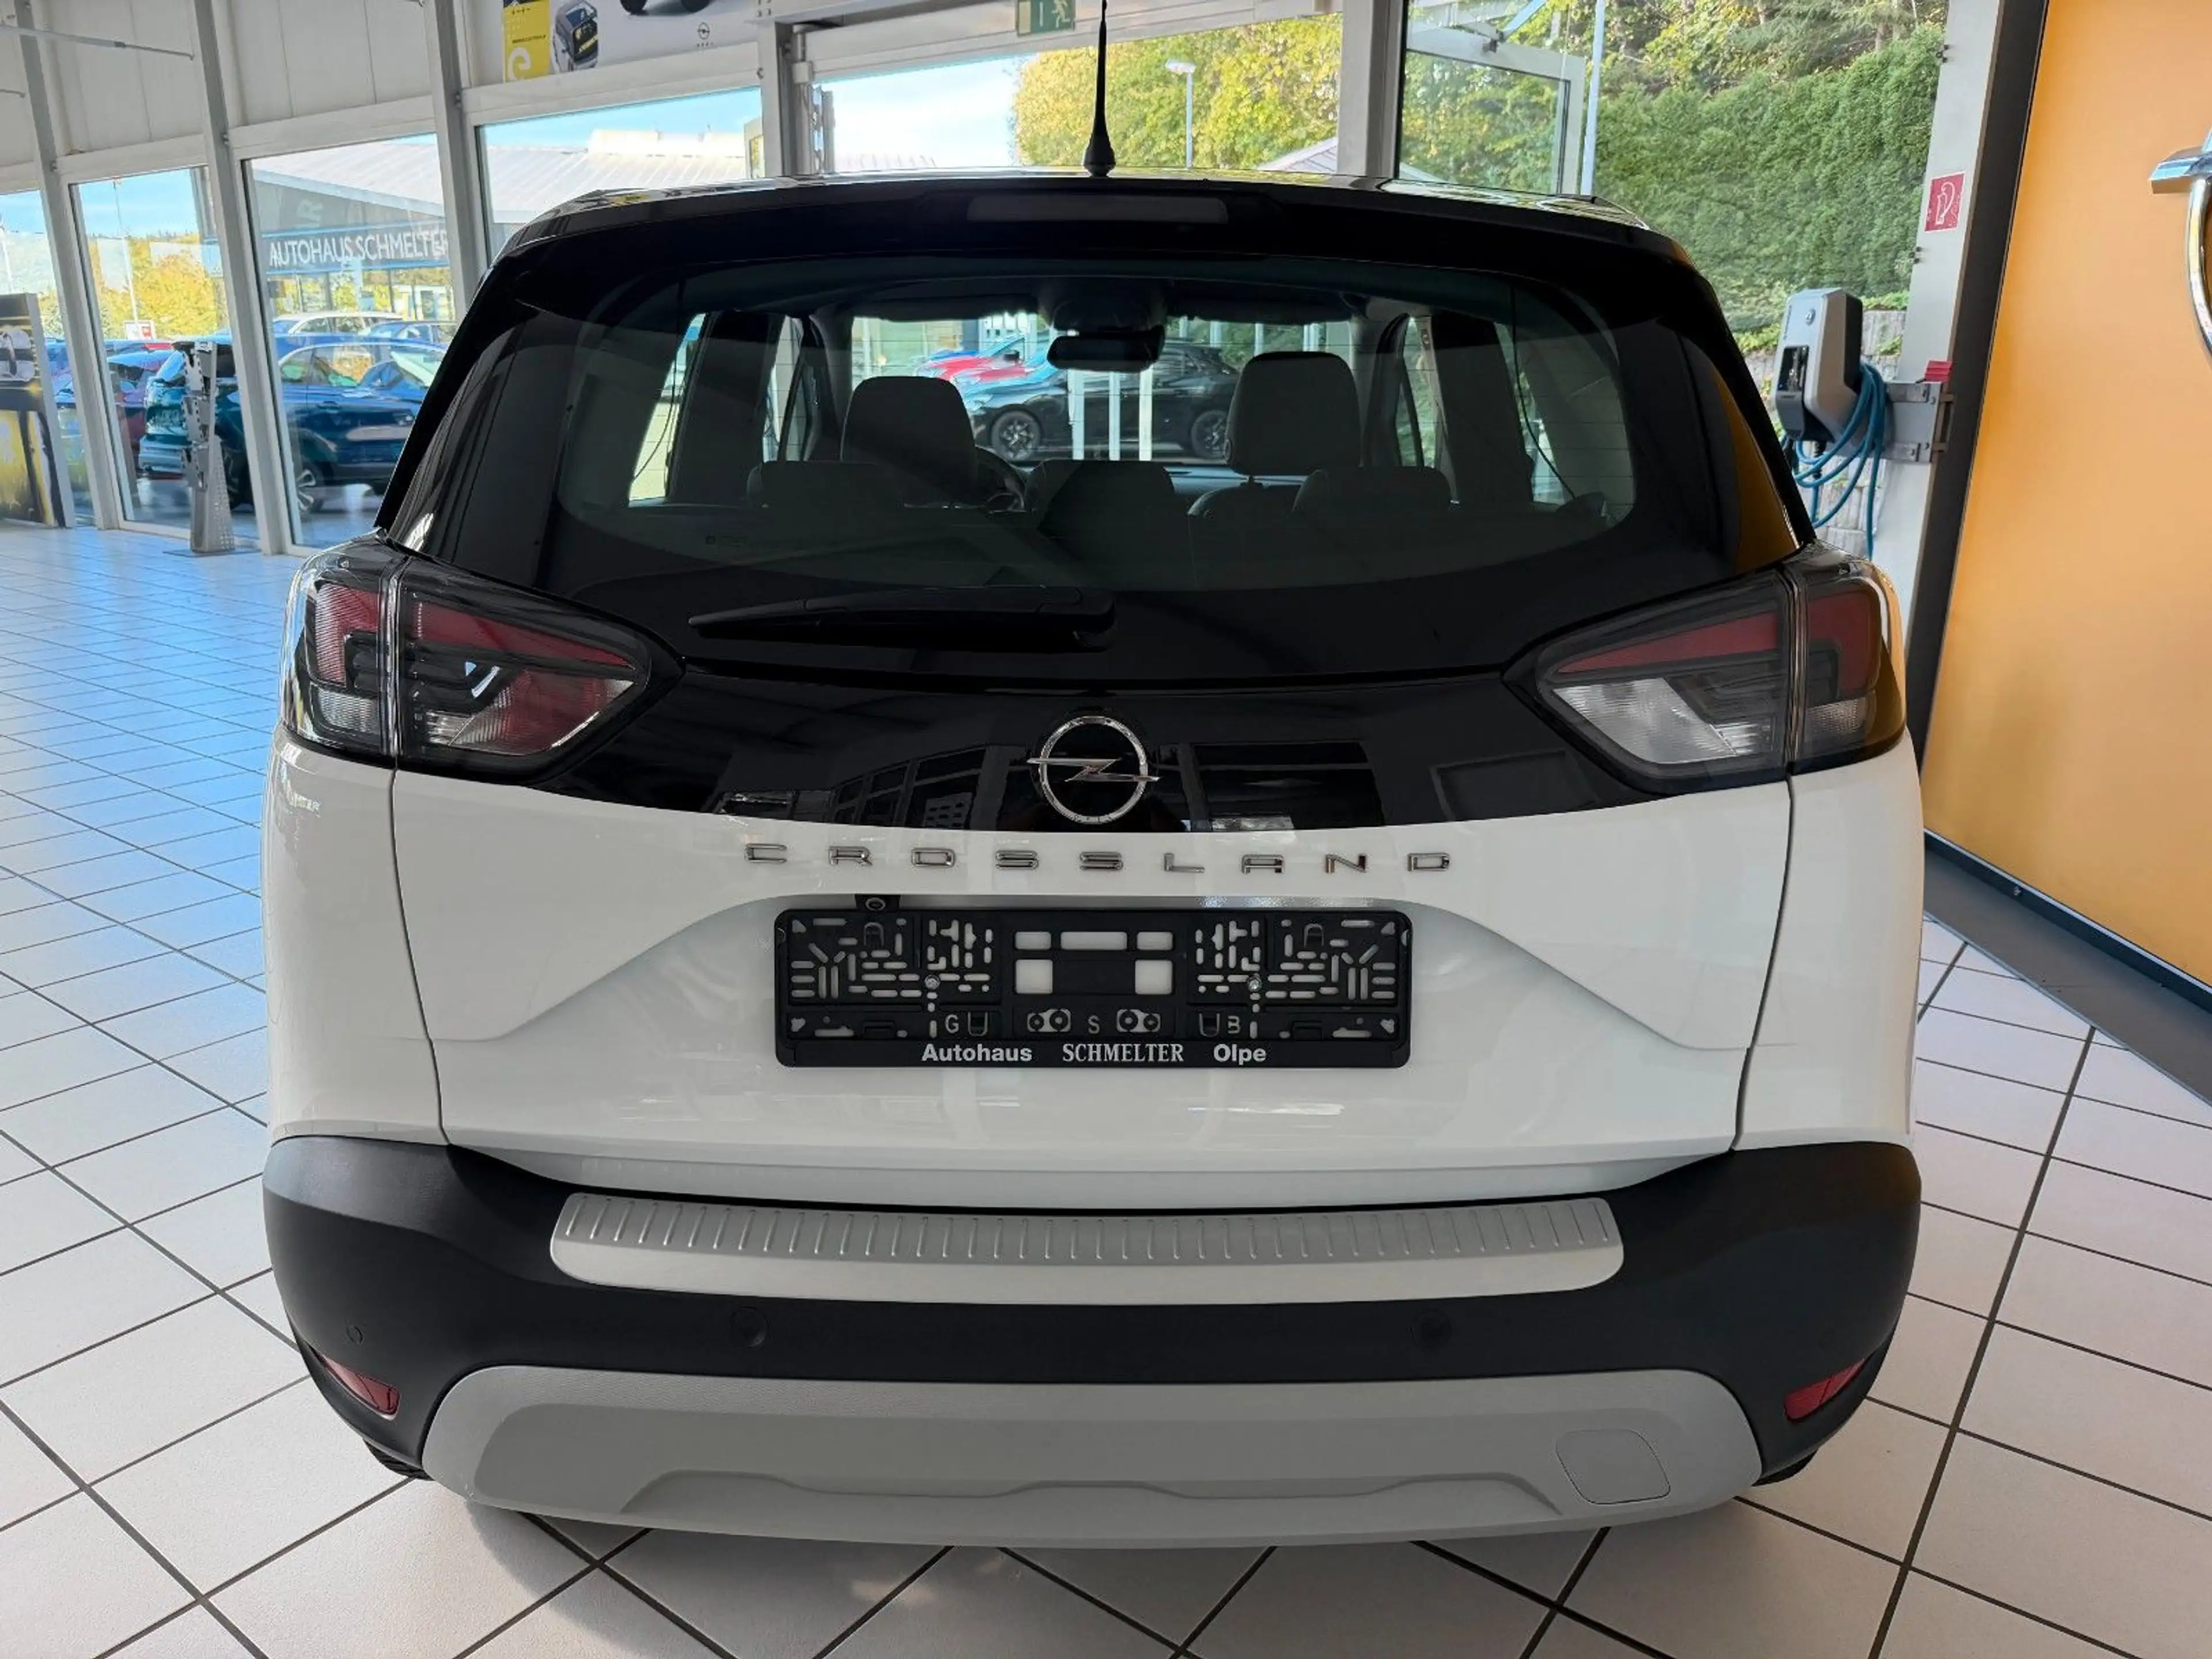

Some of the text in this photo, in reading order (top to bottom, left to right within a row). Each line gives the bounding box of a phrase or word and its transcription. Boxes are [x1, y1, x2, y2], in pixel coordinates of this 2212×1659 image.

[269, 236, 354, 268] AUTOHAUS
[744, 843, 1450, 874] CROSSLAND
[921, 1043, 1267, 1065] Autohaus SCHMELTER Olpe
